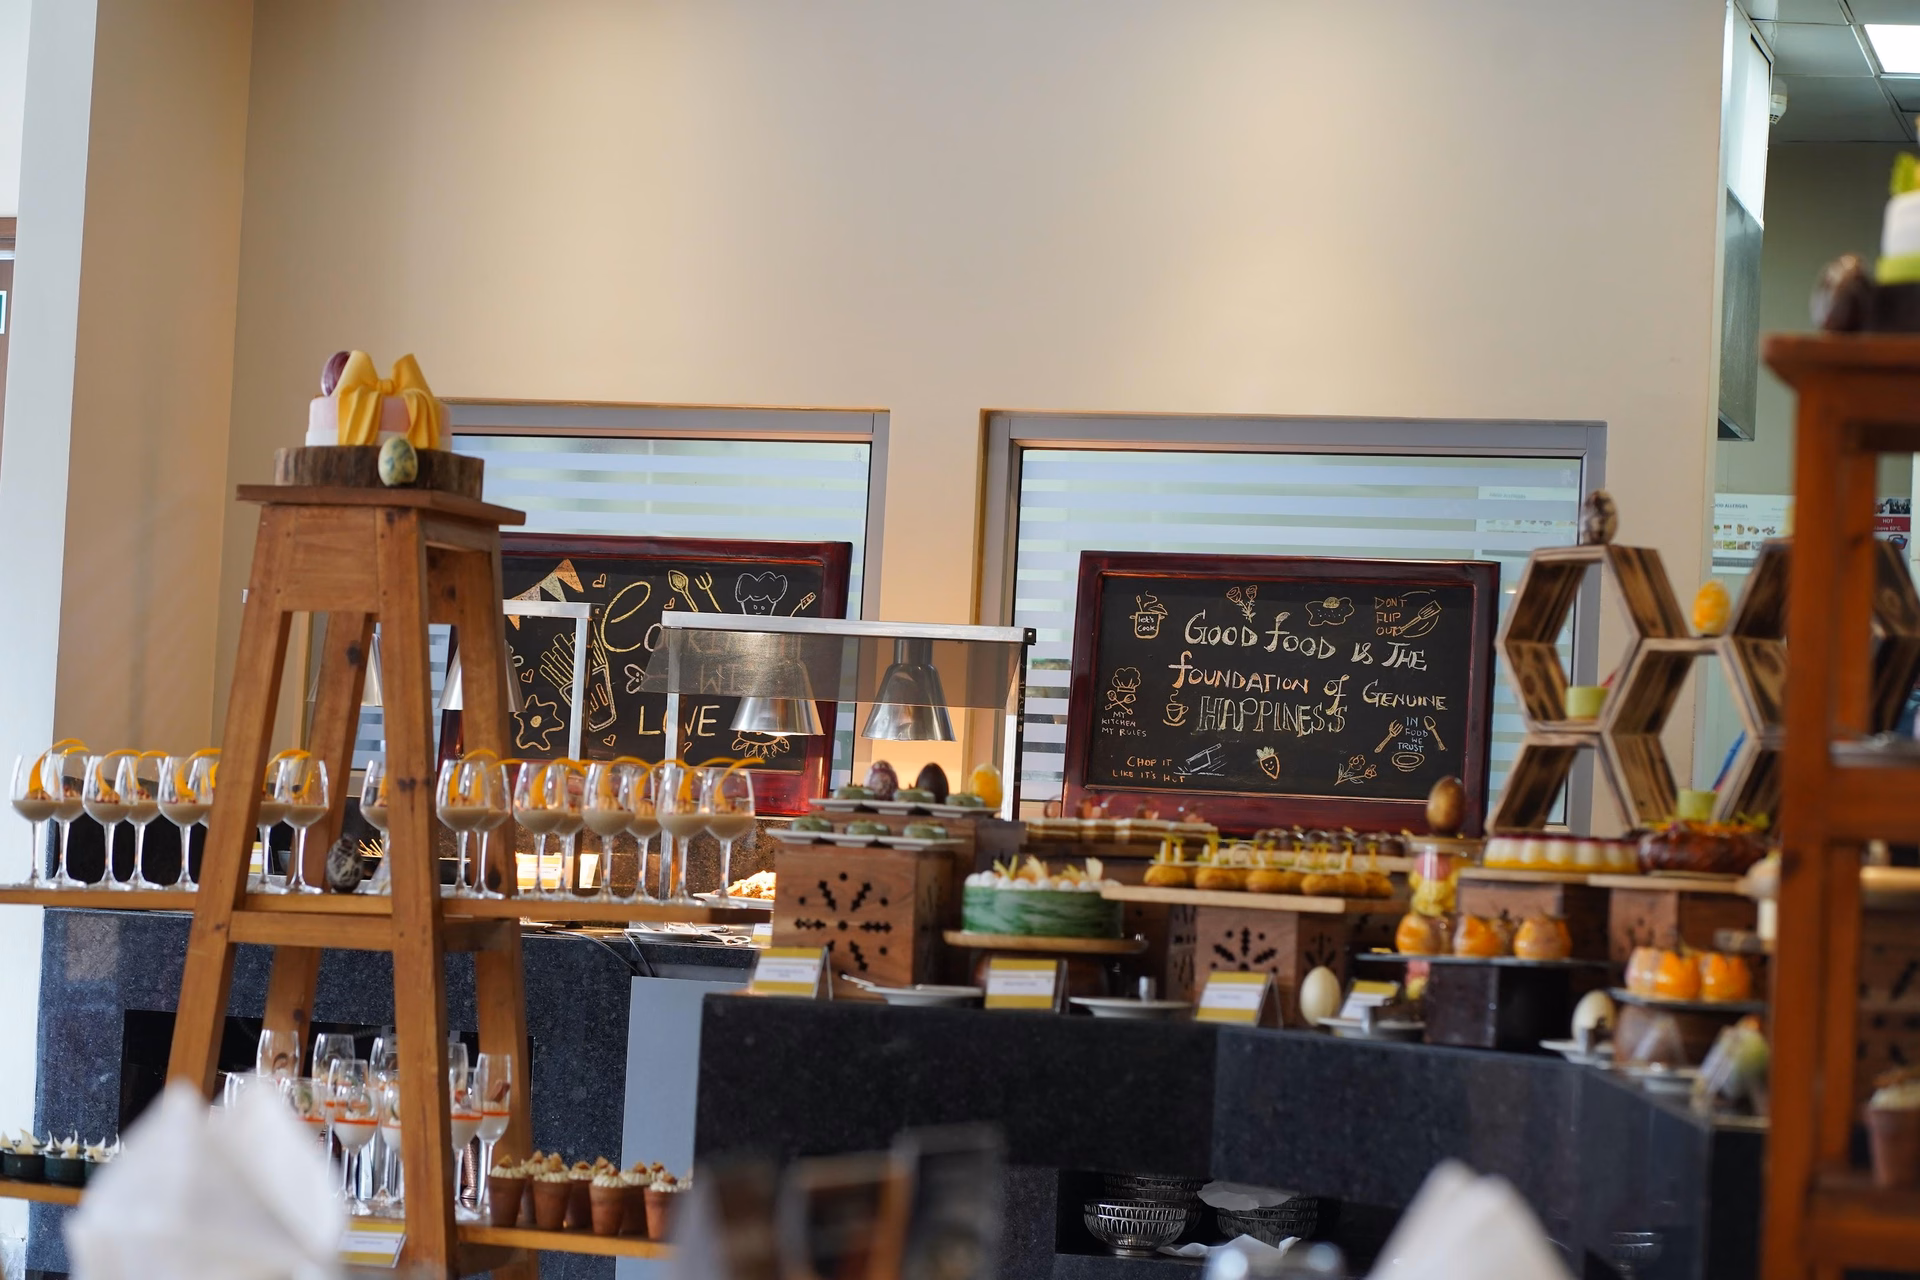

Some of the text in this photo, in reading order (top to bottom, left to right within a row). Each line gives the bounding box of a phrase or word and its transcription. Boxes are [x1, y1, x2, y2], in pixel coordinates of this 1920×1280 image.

[1374, 596, 1408, 610] DON'T
[1376, 612, 1401, 624] FLIP
[1351, 642, 1374, 665] IS
[1381, 641, 1428, 672] THE
[1362, 679, 1448, 711] GENUINE
[1112, 711, 1126, 719] MY
[1194, 694, 1348, 738] HAPPINESS
[1101, 718, 1136, 728] KITCHEN
[1406, 716, 1419, 727] IN
[1101, 727, 1147, 738] MY RULES
[1405, 728, 1429, 738] FOOD
[1411, 737, 1423, 745] WE
[1397, 742, 1425, 753] TRUST
[1126, 755, 1173, 767] CHOP IT
[1112, 769, 1134, 778] LIKE
[1140, 770, 1156, 780] IT'S
